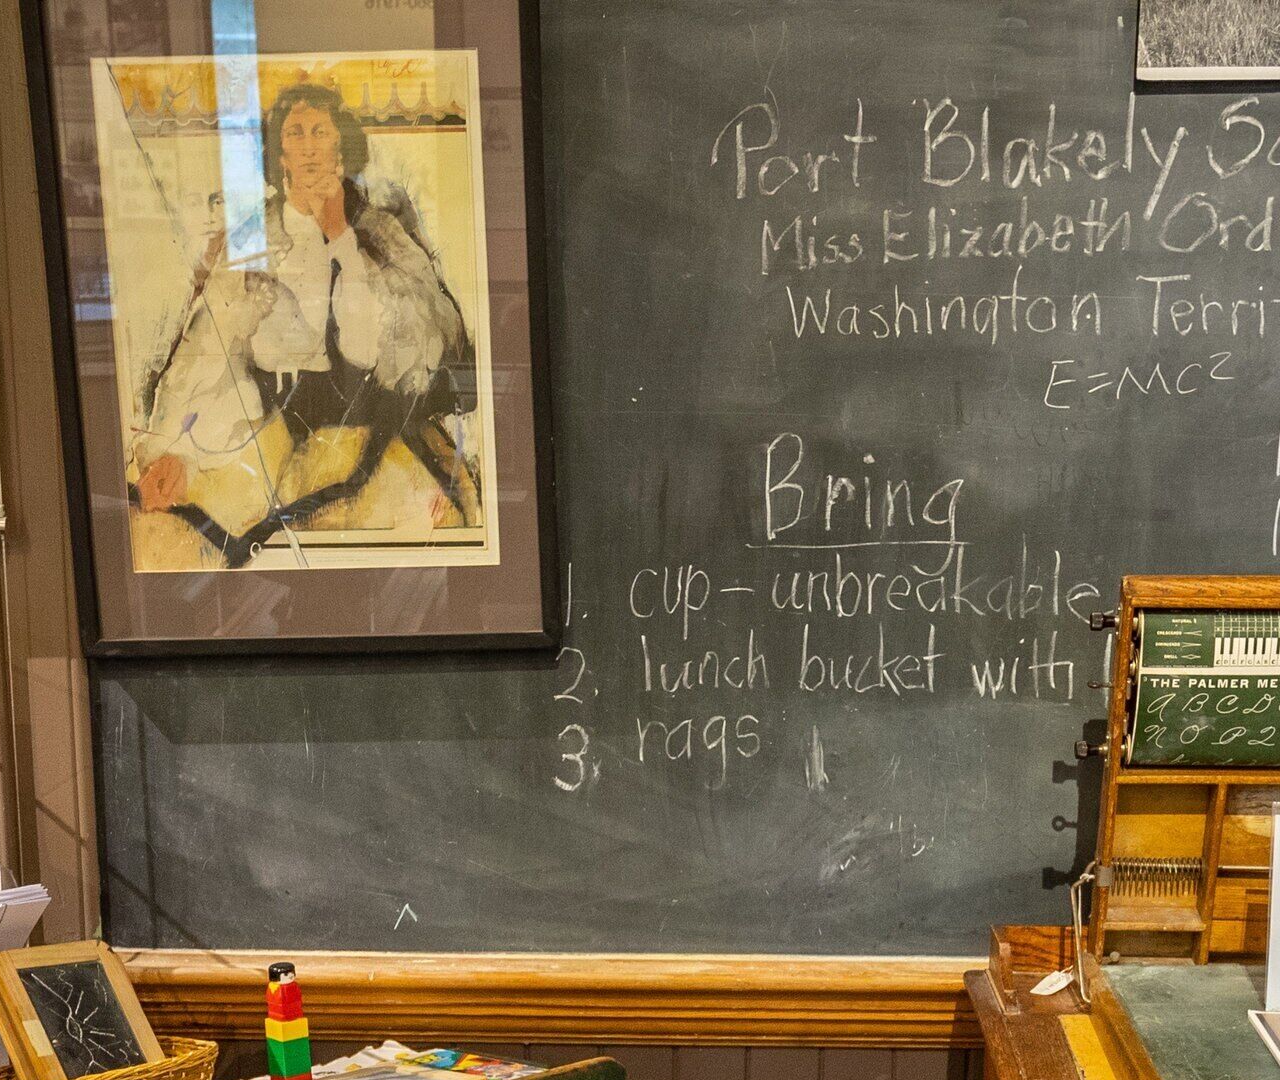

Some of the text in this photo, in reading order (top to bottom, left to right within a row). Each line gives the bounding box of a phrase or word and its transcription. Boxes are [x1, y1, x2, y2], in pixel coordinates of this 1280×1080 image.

[710, 97, 877, 199] Port
[921, 93, 1188, 220] Blakely
[762, 217, 862, 275] Miss
[882, 196, 1132, 264] Elizabeth
[786, 265, 1102, 345] Washington
[766, 432, 964, 575] Bring
[641, 629, 769, 697] lunch
[799, 622, 946, 695] bucket
[971, 629, 1075, 701] with
[1150, 678, 1180, 689] THE
[1188, 678, 1249, 689] PALMER
[636, 714, 762, 792] rags
